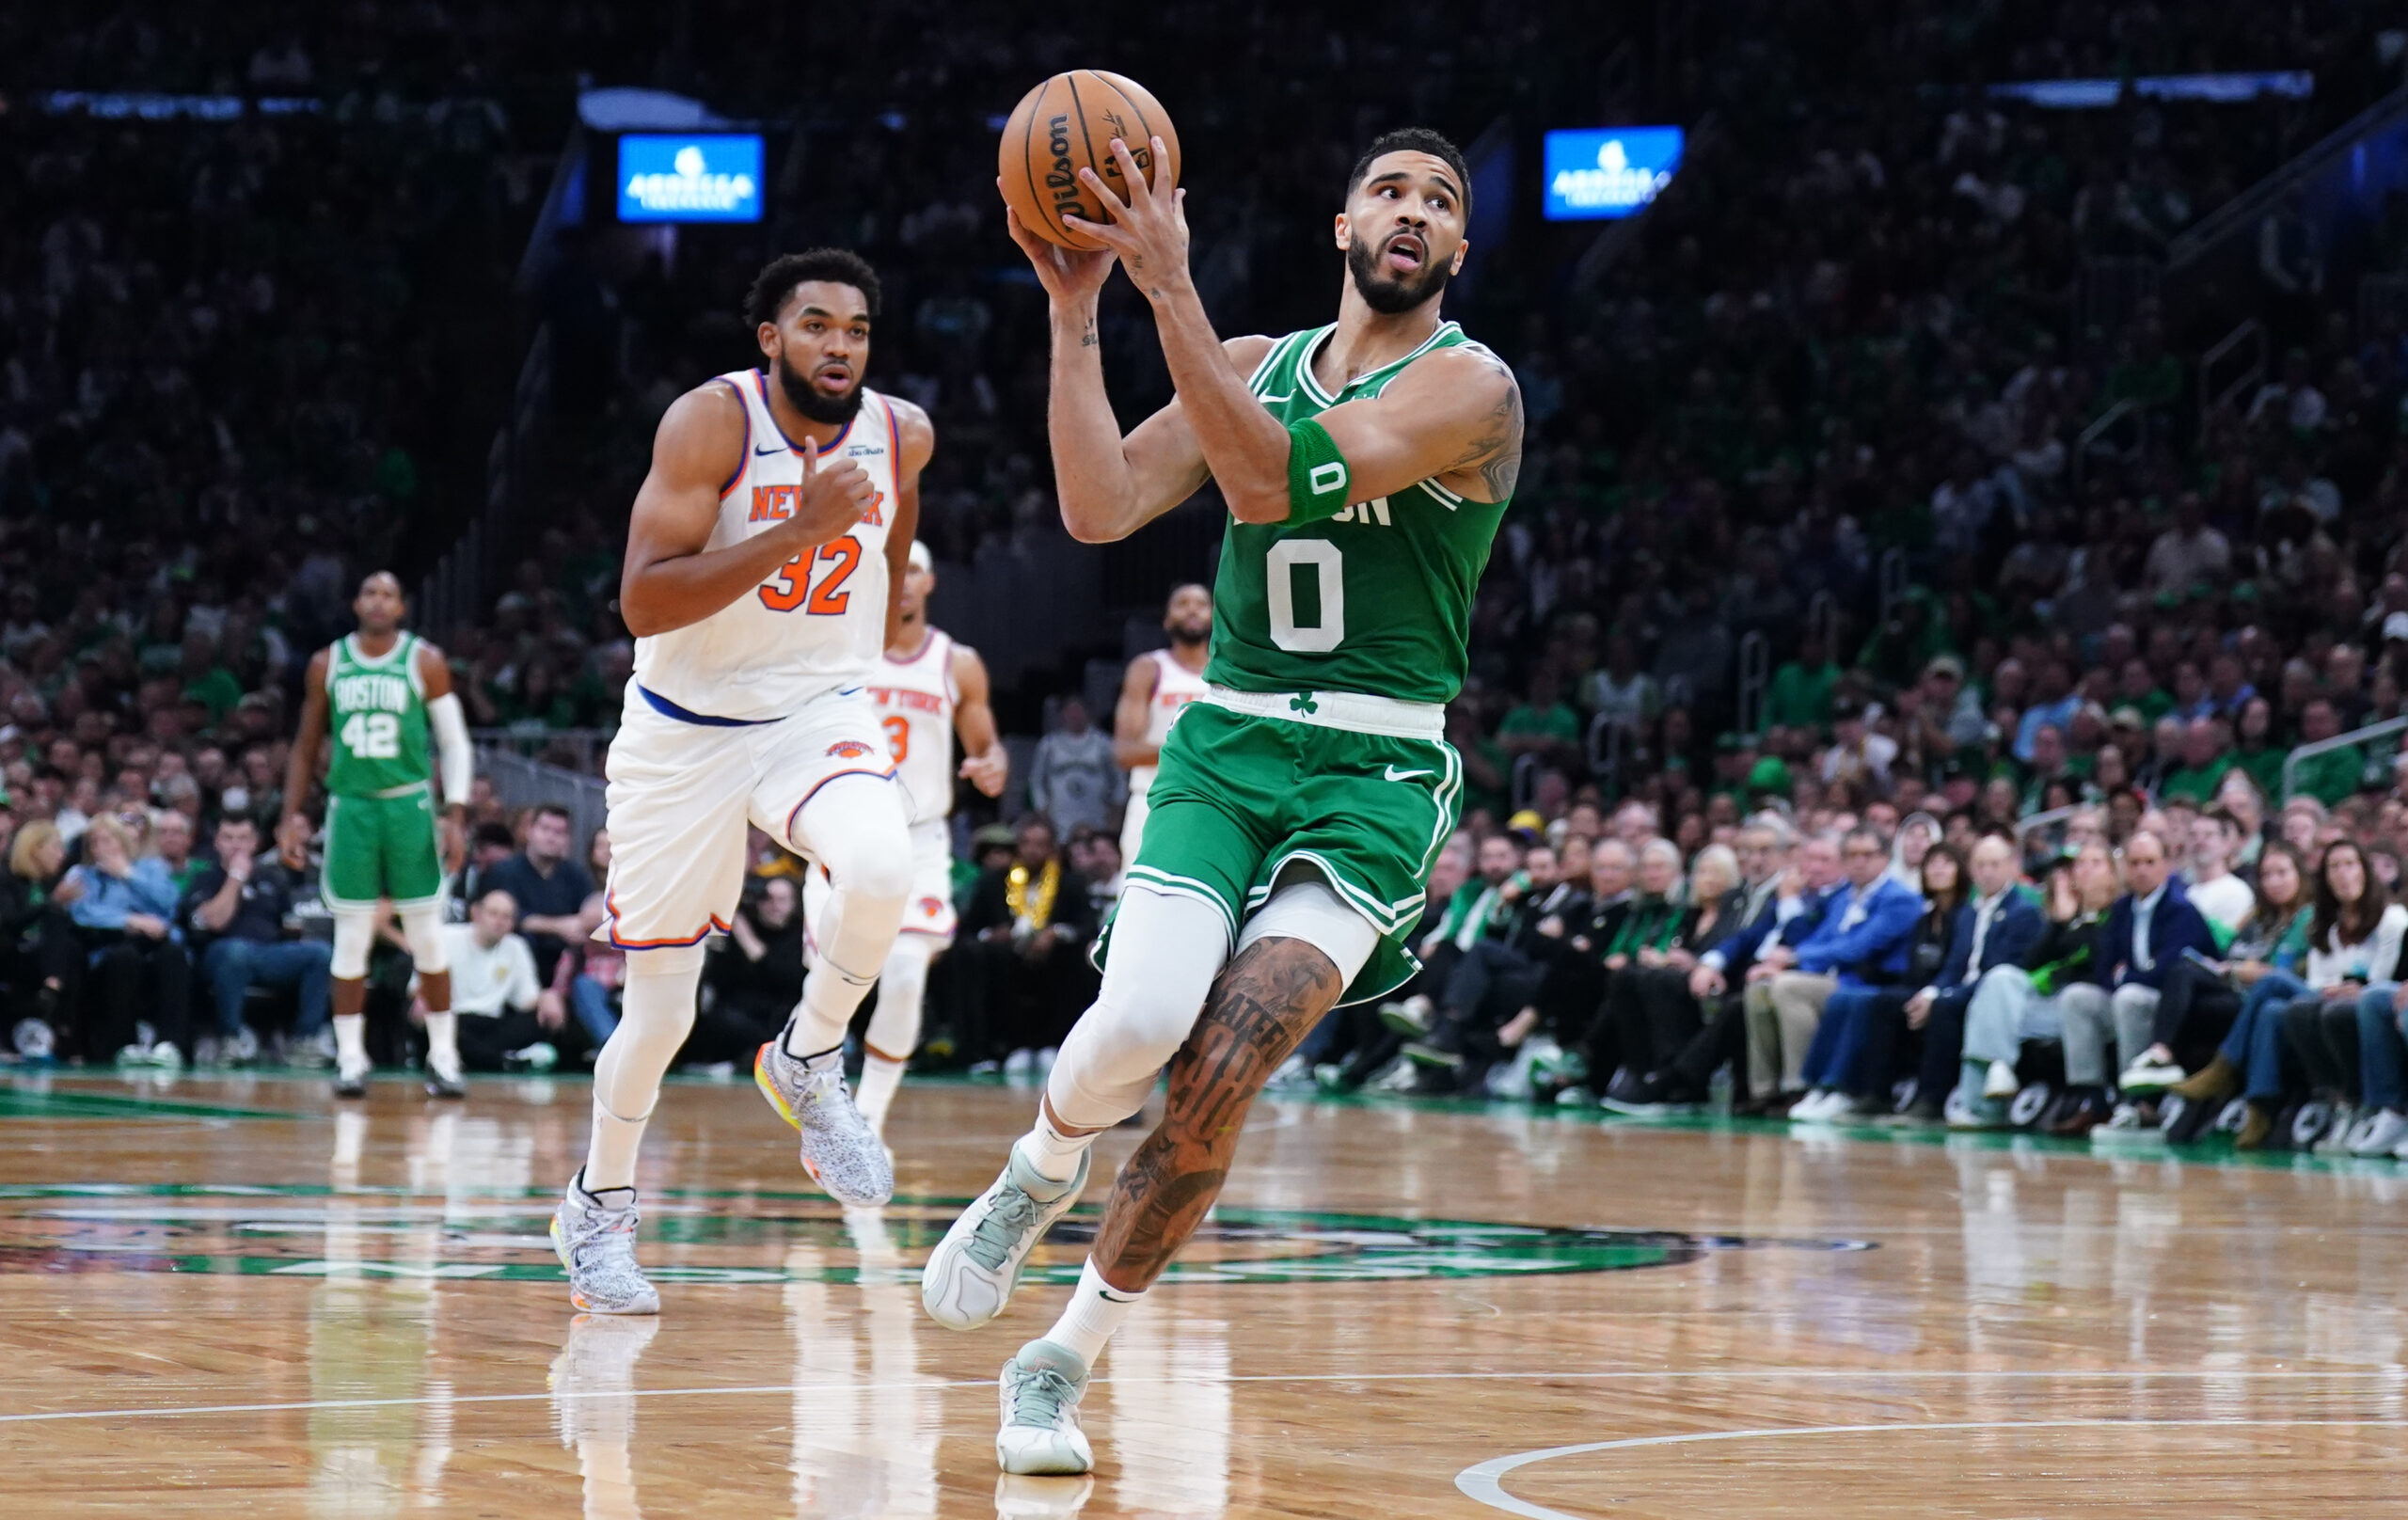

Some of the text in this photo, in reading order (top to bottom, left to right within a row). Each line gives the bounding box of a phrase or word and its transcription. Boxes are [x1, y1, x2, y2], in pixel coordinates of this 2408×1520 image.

[1309, 462, 1347, 495] 0
[757, 534, 863, 616] 32
[1266, 539, 1344, 653] 0
[334, 673, 406, 715] BOSTON
[341, 712, 400, 758] 42
[882, 715, 910, 765] 3
